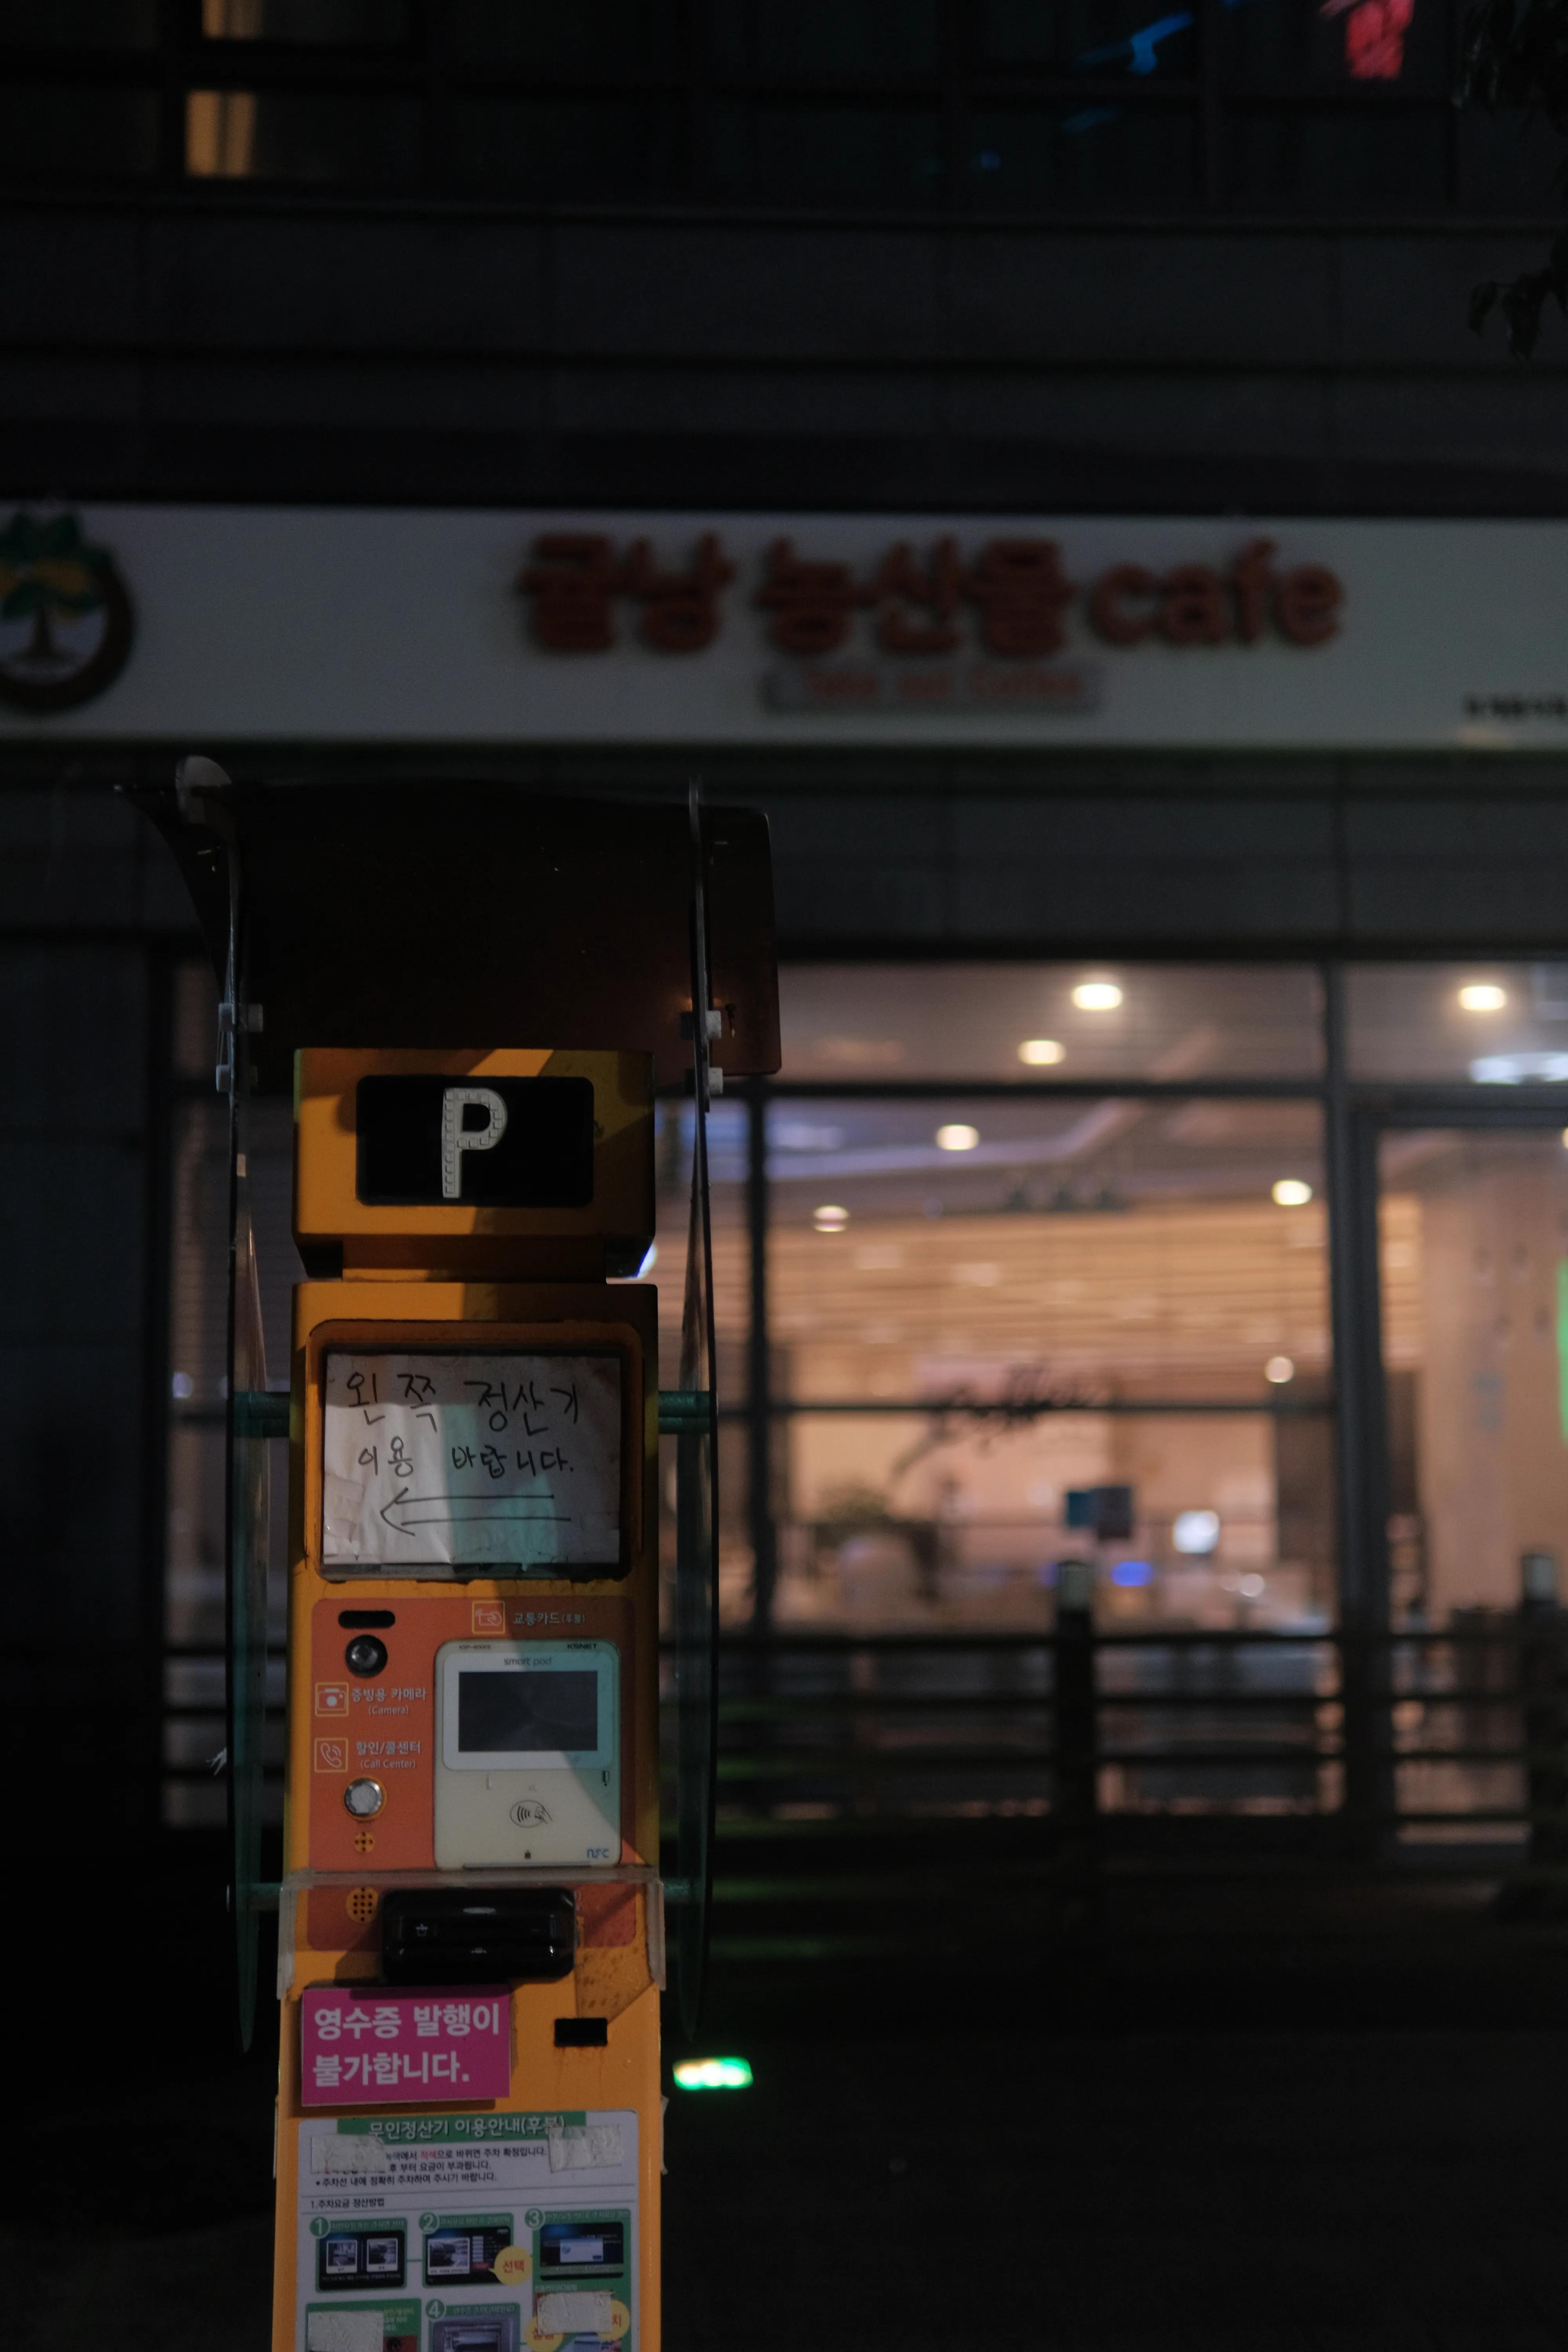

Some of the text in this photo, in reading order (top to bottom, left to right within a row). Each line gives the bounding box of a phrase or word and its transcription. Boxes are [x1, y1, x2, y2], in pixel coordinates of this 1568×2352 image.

[753, 535, 1073, 656] 농산물
[1090, 539, 1342, 646] cafe
[441, 1087, 508, 1199] P
[347, 1371, 579, 1437] 왼쪽 정산기
[358, 1436, 574, 1479] 이용 바랍니다.
[391, 1688, 426, 1701] 카메라
[368, 1705, 409, 1715] (Camera)
[360, 1759, 416, 1769] (Call Center)
[314, 2003, 499, 2040] 영수증 발행이
[313, 2050, 470, 2087] 불가합니다.
[420, 2161, 444, 2171] 요금이
[503, 2259, 524, 2274] 선택
[428, 2301, 441, 2318] 4
